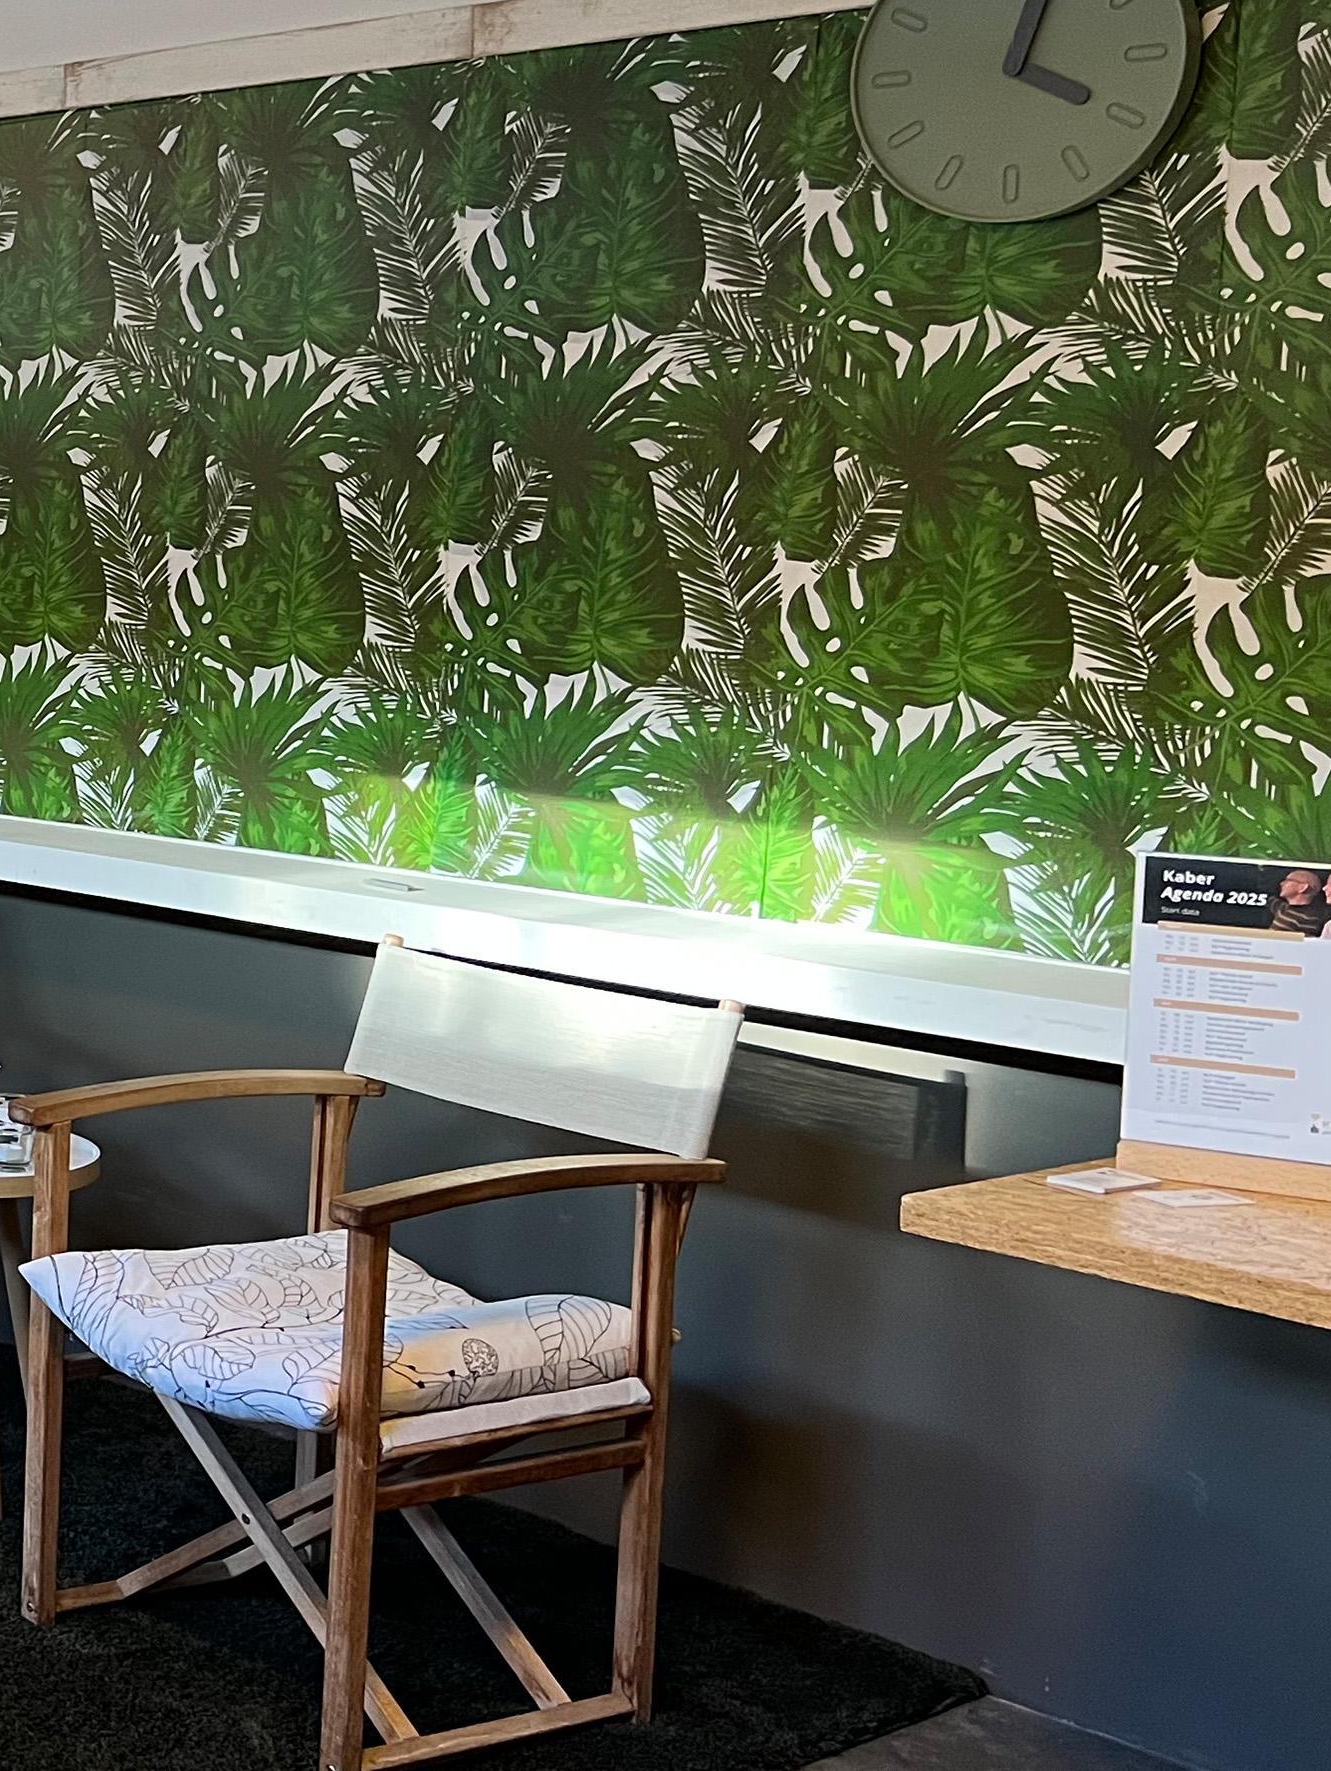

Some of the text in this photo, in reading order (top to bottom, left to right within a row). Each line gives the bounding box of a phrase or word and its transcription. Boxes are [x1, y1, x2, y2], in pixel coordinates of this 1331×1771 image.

[1162, 869, 1215, 886] Kaber
[1160, 886, 1268, 906] Agenda 2025
